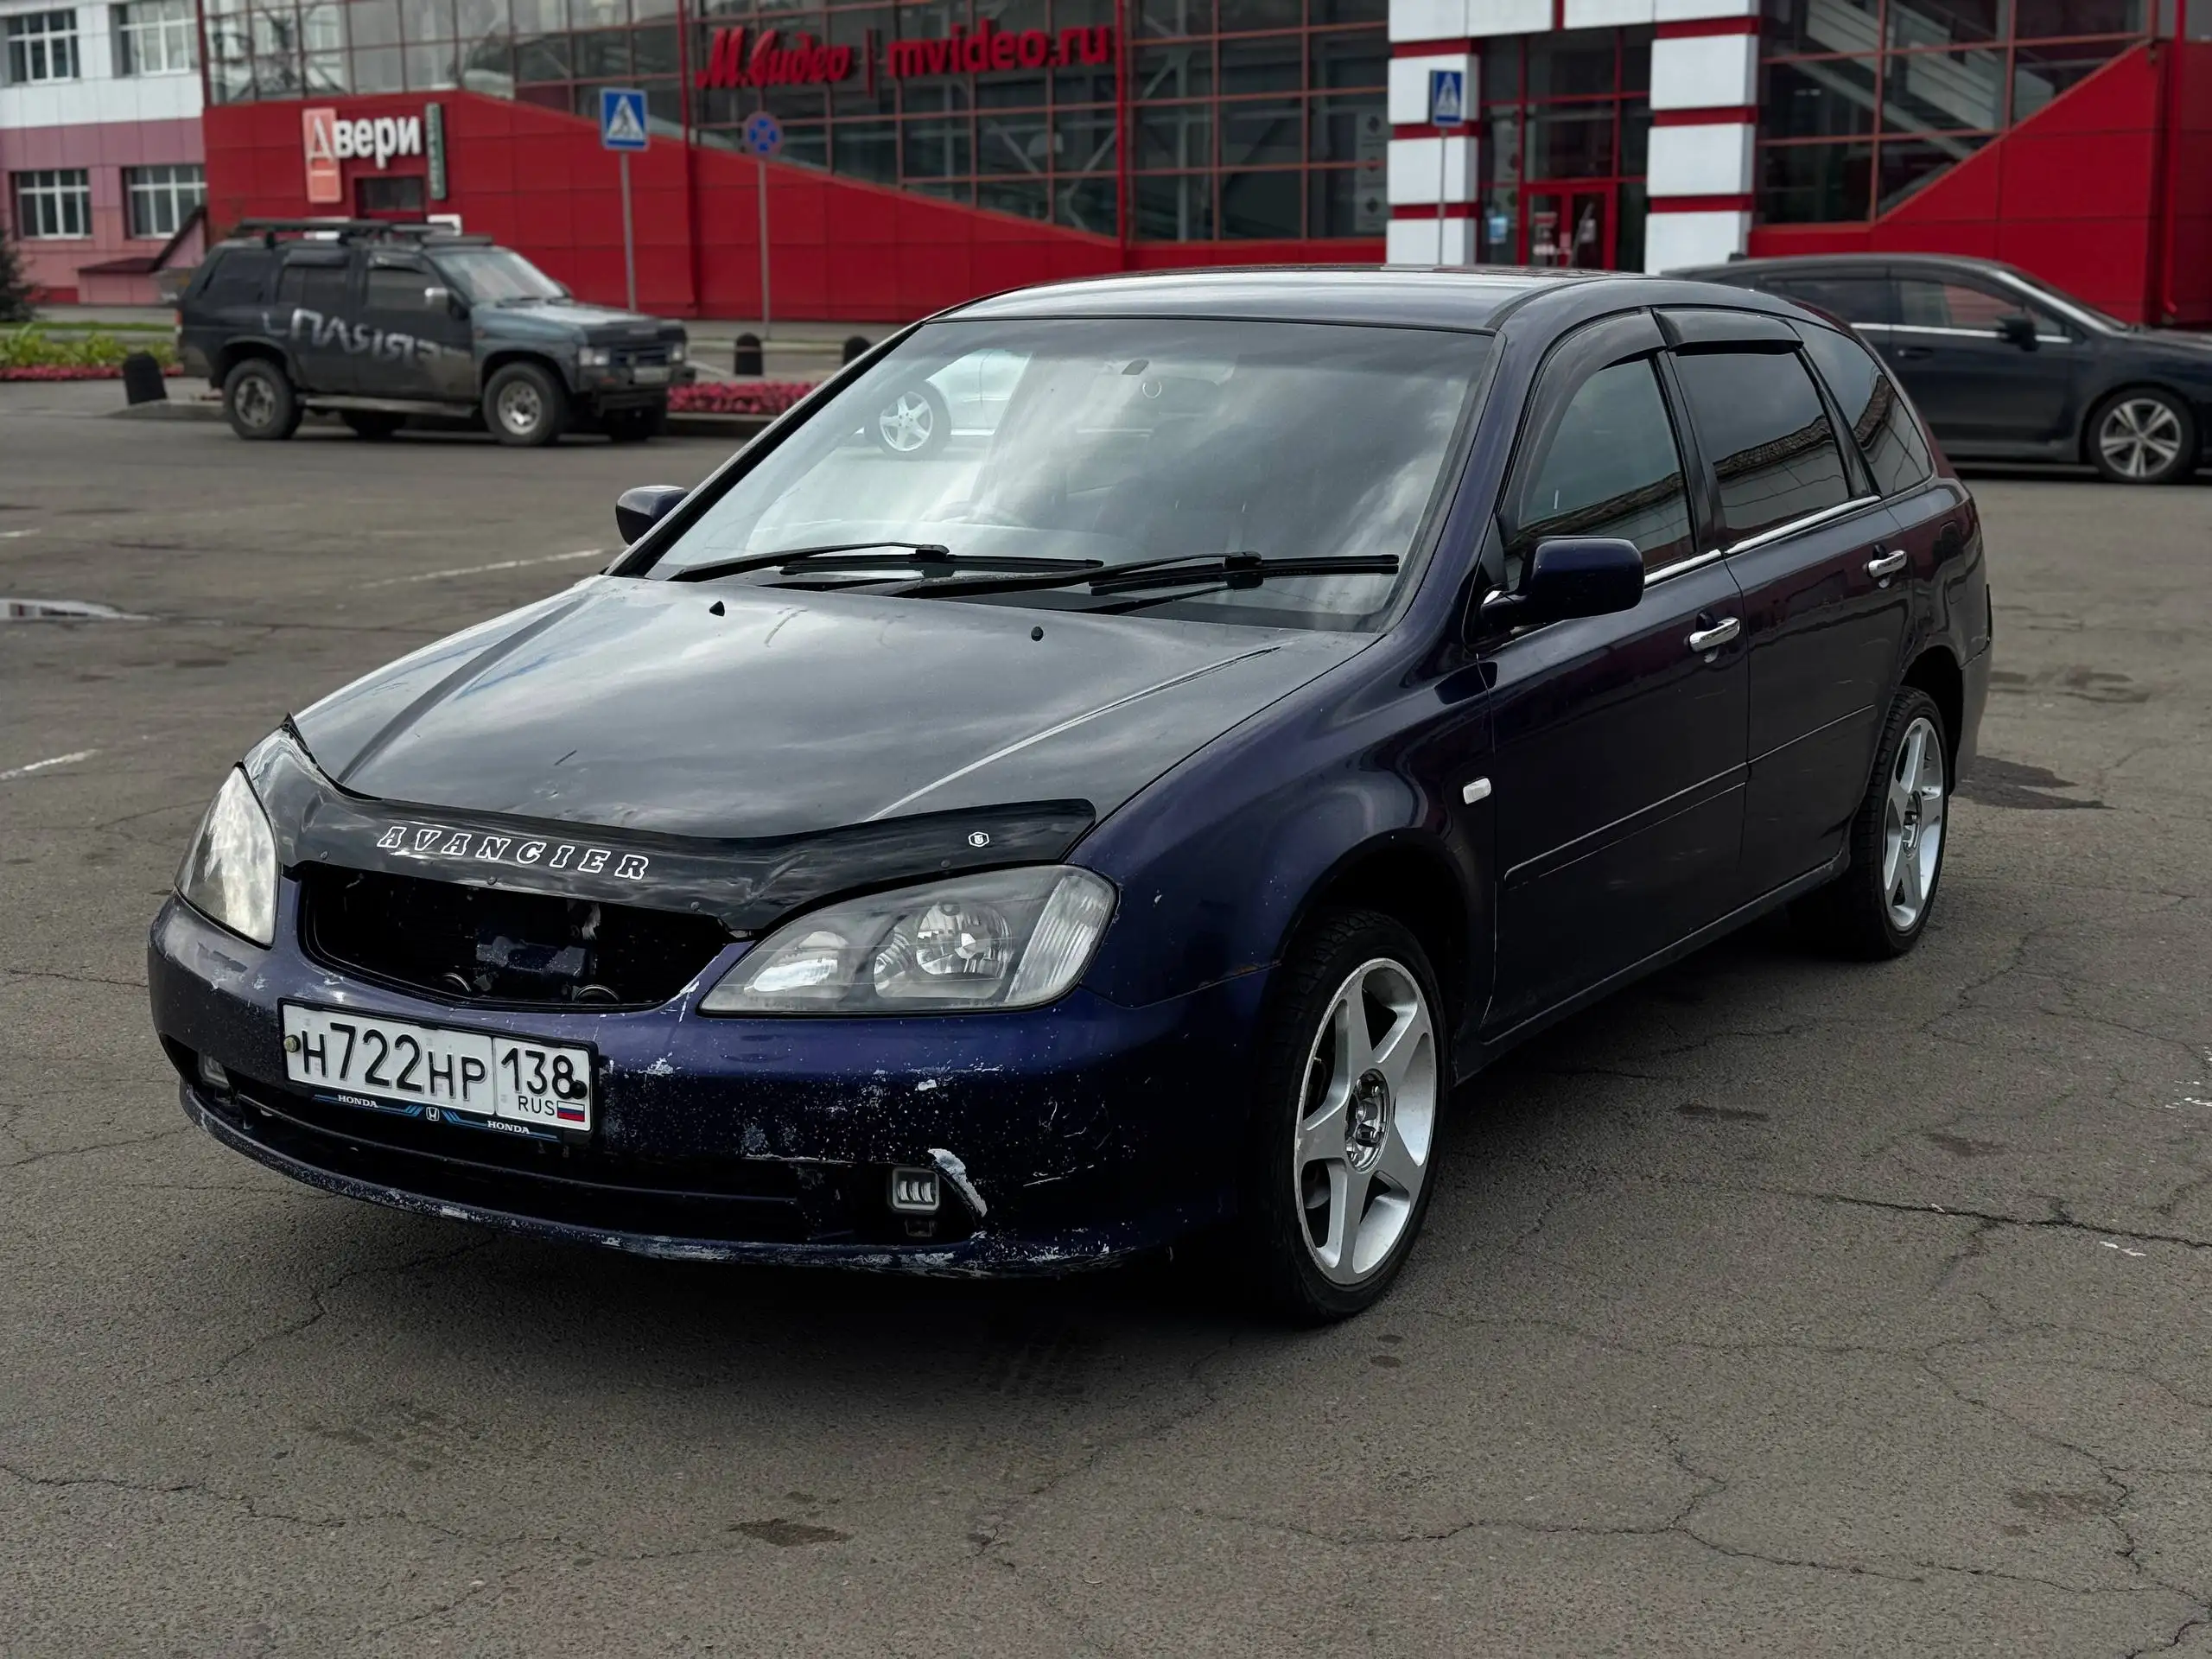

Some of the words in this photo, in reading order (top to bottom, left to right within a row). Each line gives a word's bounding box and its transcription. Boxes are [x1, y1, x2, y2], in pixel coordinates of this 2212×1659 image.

[887, 18, 1109, 77] mvideo.ru
[305, 116, 422, 169] Двери
[378, 826, 648, 880] AVANCIER
[501, 1047, 580, 1100] 138
[338, 1094, 378, 1109] HONDA
[486, 1120, 531, 1135] HONDA
[518, 1095, 556, 1116] RUS
